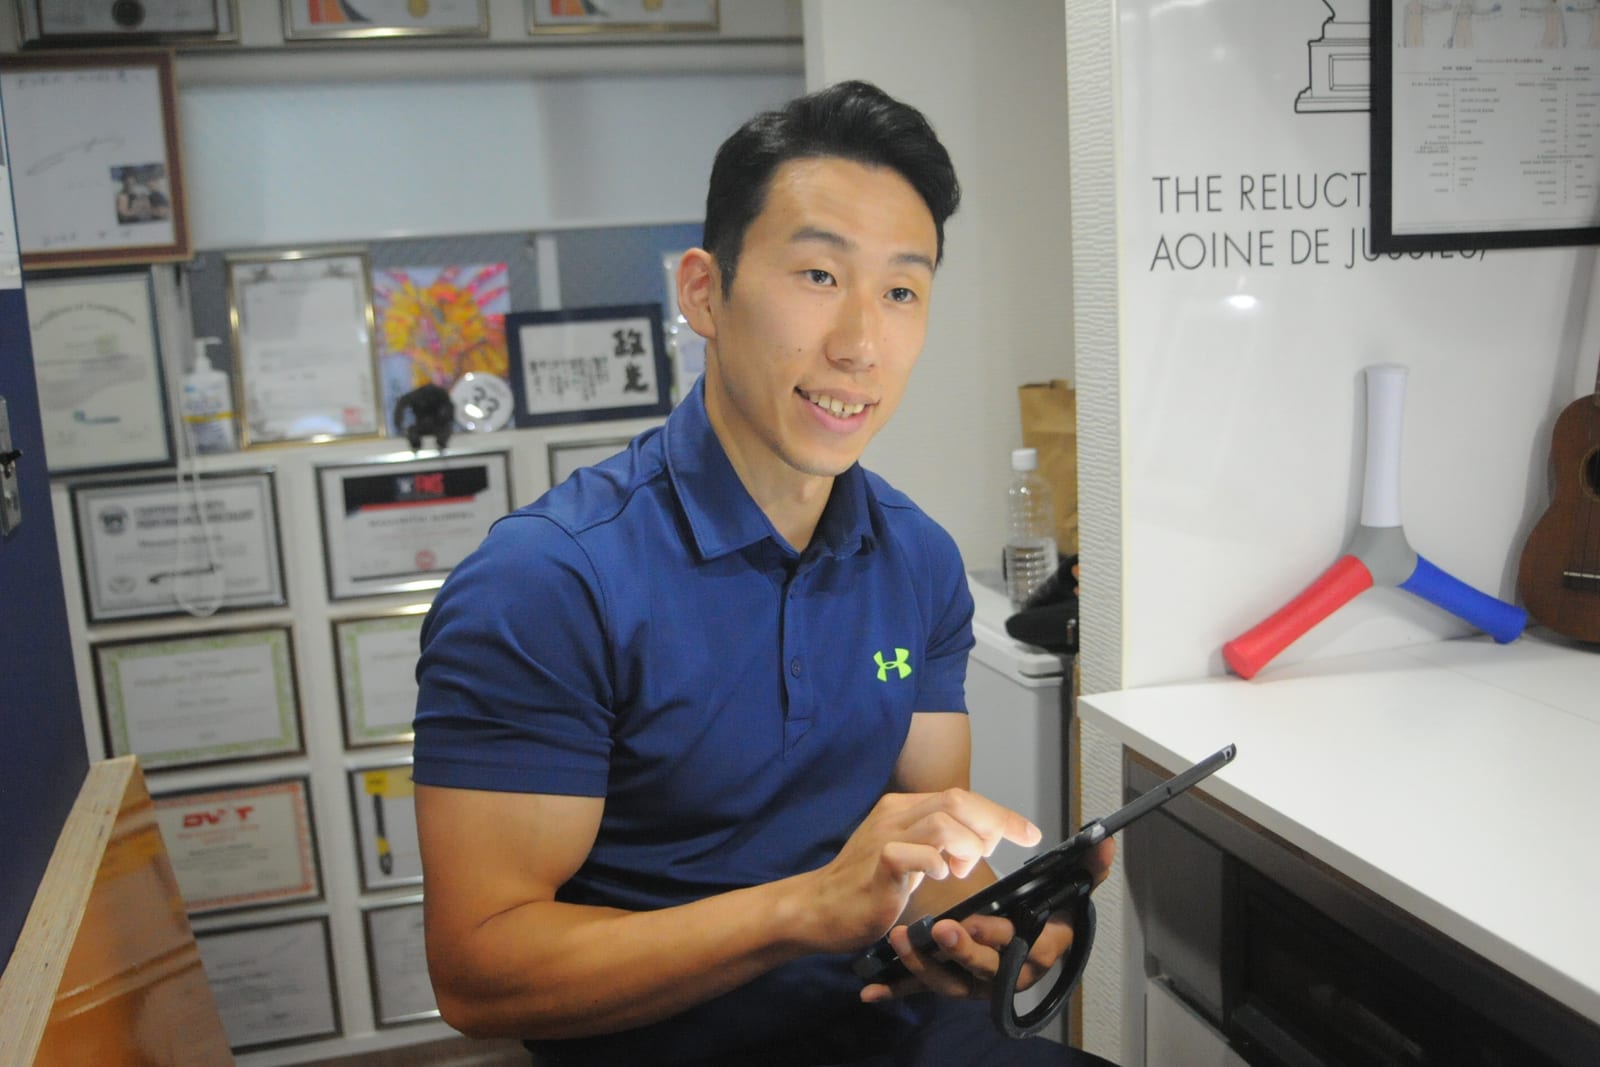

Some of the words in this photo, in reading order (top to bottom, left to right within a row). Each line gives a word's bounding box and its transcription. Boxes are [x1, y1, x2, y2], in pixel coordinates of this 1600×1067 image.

[1152, 175, 1222, 213] THE
[1240, 172, 1368, 211] RELUCT
[1150, 230, 1275, 271] AOINE
[1290, 228, 1330, 265] DE
